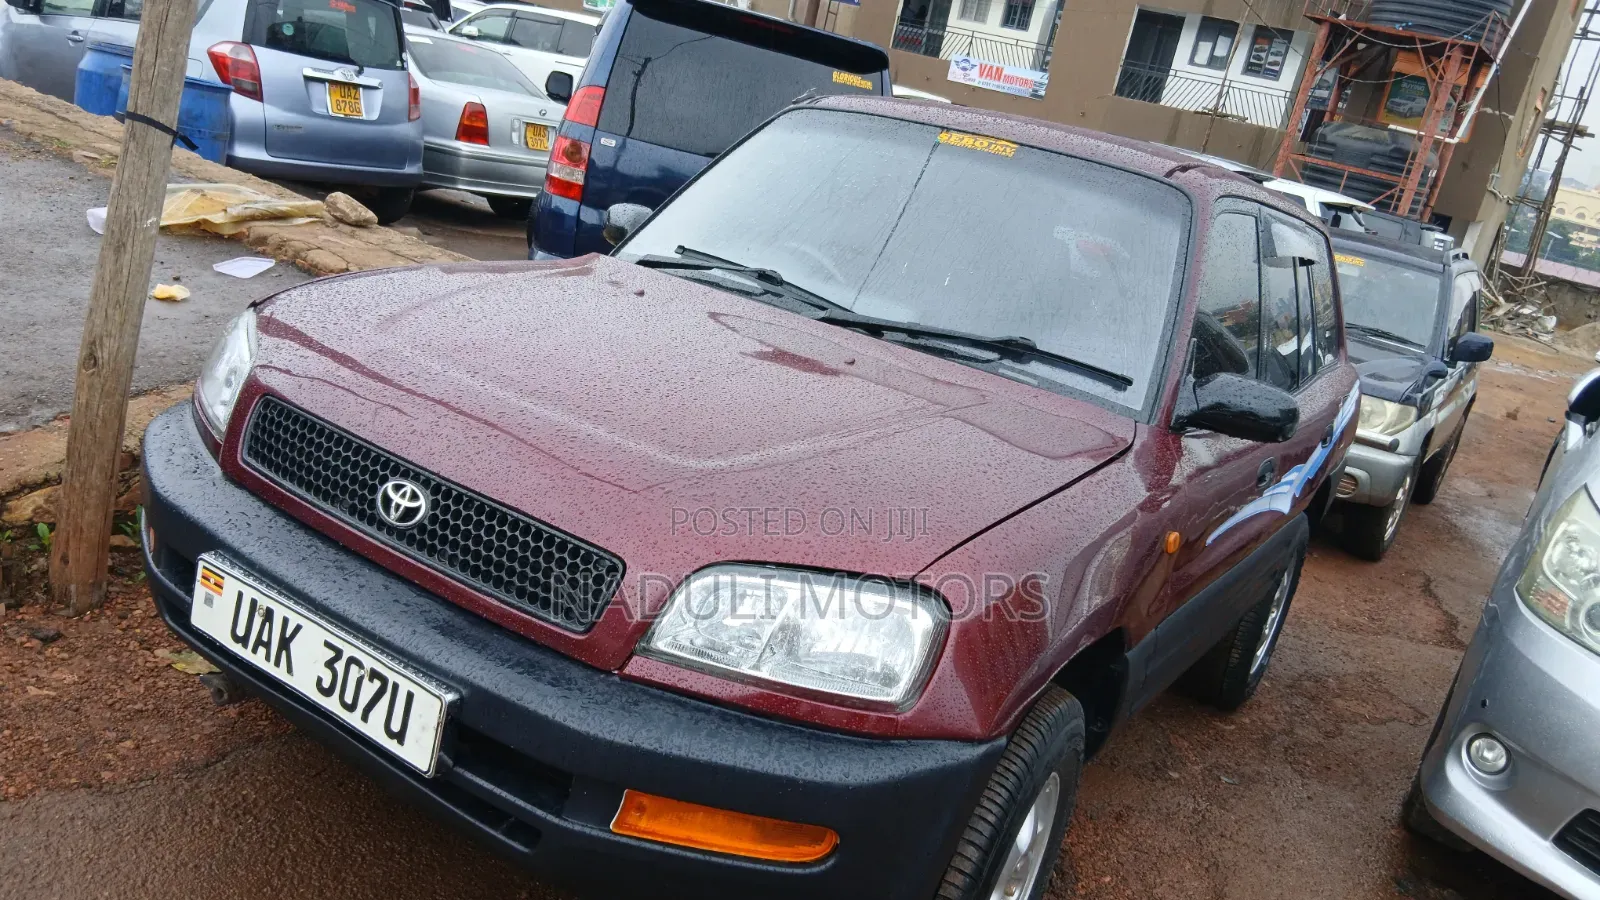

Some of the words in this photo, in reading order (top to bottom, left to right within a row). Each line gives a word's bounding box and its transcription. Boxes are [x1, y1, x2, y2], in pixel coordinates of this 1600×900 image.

[979, 63, 1004, 82] VAN
[1003, 73, 1035, 89] MOTORS
[339, 84, 360, 100] UAZ
[335, 99, 361, 114] 878G
[533, 124, 548, 139] UAS
[230, 590, 304, 677] UAK
[315, 639, 415, 747] 307U
